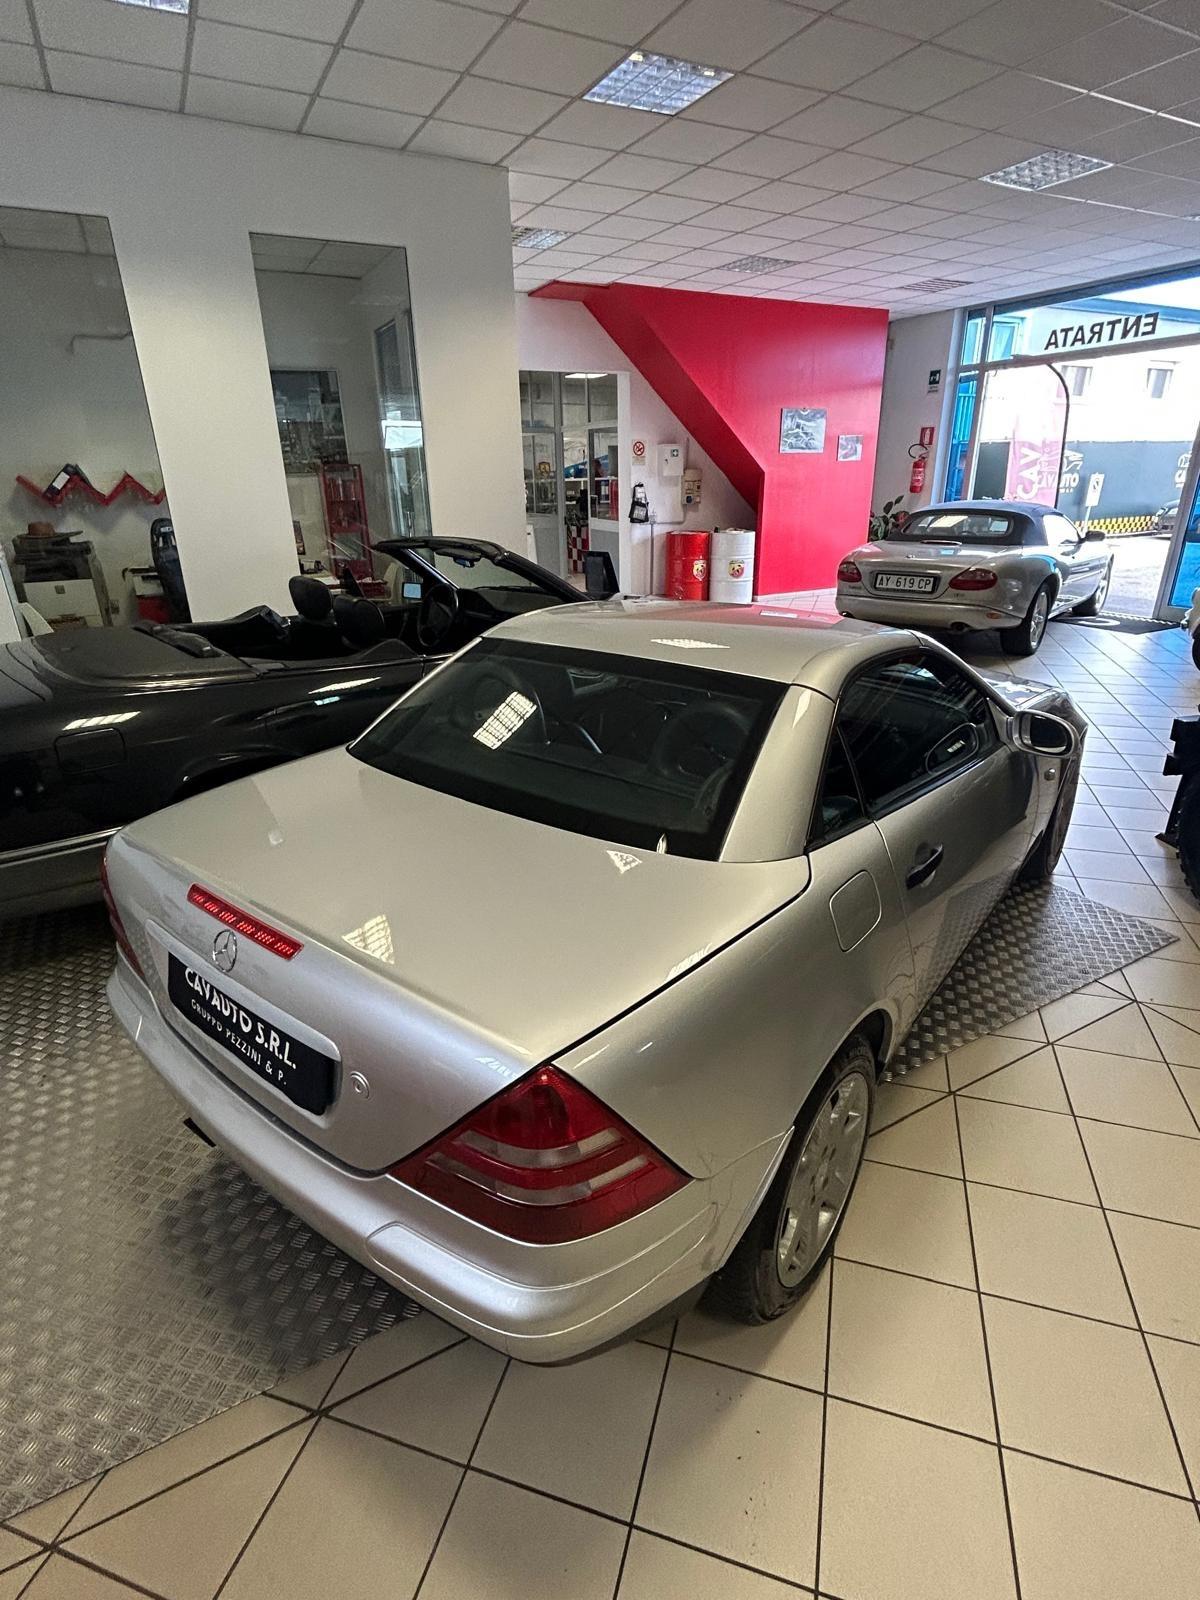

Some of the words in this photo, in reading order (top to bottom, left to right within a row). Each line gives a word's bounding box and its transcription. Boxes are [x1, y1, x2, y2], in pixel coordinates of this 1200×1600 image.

[879, 576, 891, 587] AY
[895, 577, 915, 588] 619
[918, 579, 931, 590] CP
[184, 967, 253, 1033] CAVAUTO
[255, 1021, 297, 1070] S.R.L.
[191, 999, 223, 1032] GRUPPO
[225, 1028, 262, 1065] PEZZINI
[265, 1060, 273, 1075] &
[278, 1069, 287, 1085] P.
